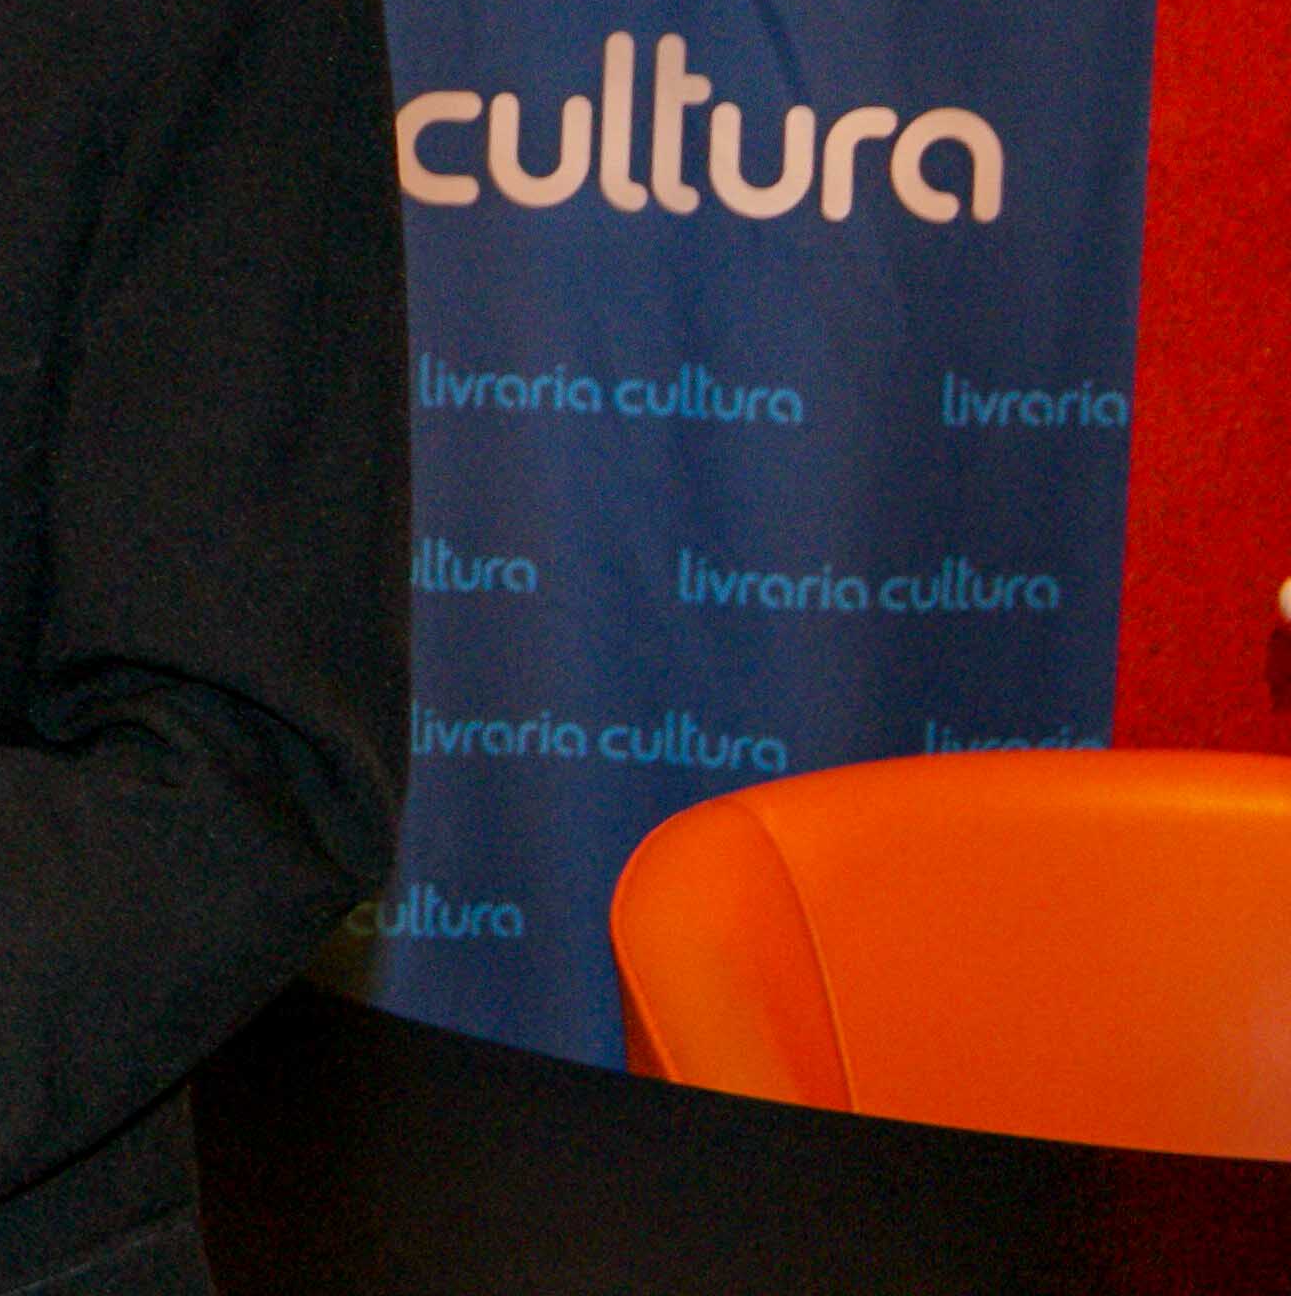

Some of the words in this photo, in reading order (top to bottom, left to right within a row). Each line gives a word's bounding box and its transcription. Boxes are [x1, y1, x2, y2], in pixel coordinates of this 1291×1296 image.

[396, 30, 1005, 225] cultura
[420, 354, 603, 413] livraria
[613, 363, 804, 425] cultura
[942, 373, 1129, 427] livraria
[411, 538, 539, 593] ltura
[677, 549, 869, 612] livraria
[879, 558, 1060, 612] cultura
[411, 704, 587, 758] livraria
[598, 711, 787, 773] cultura
